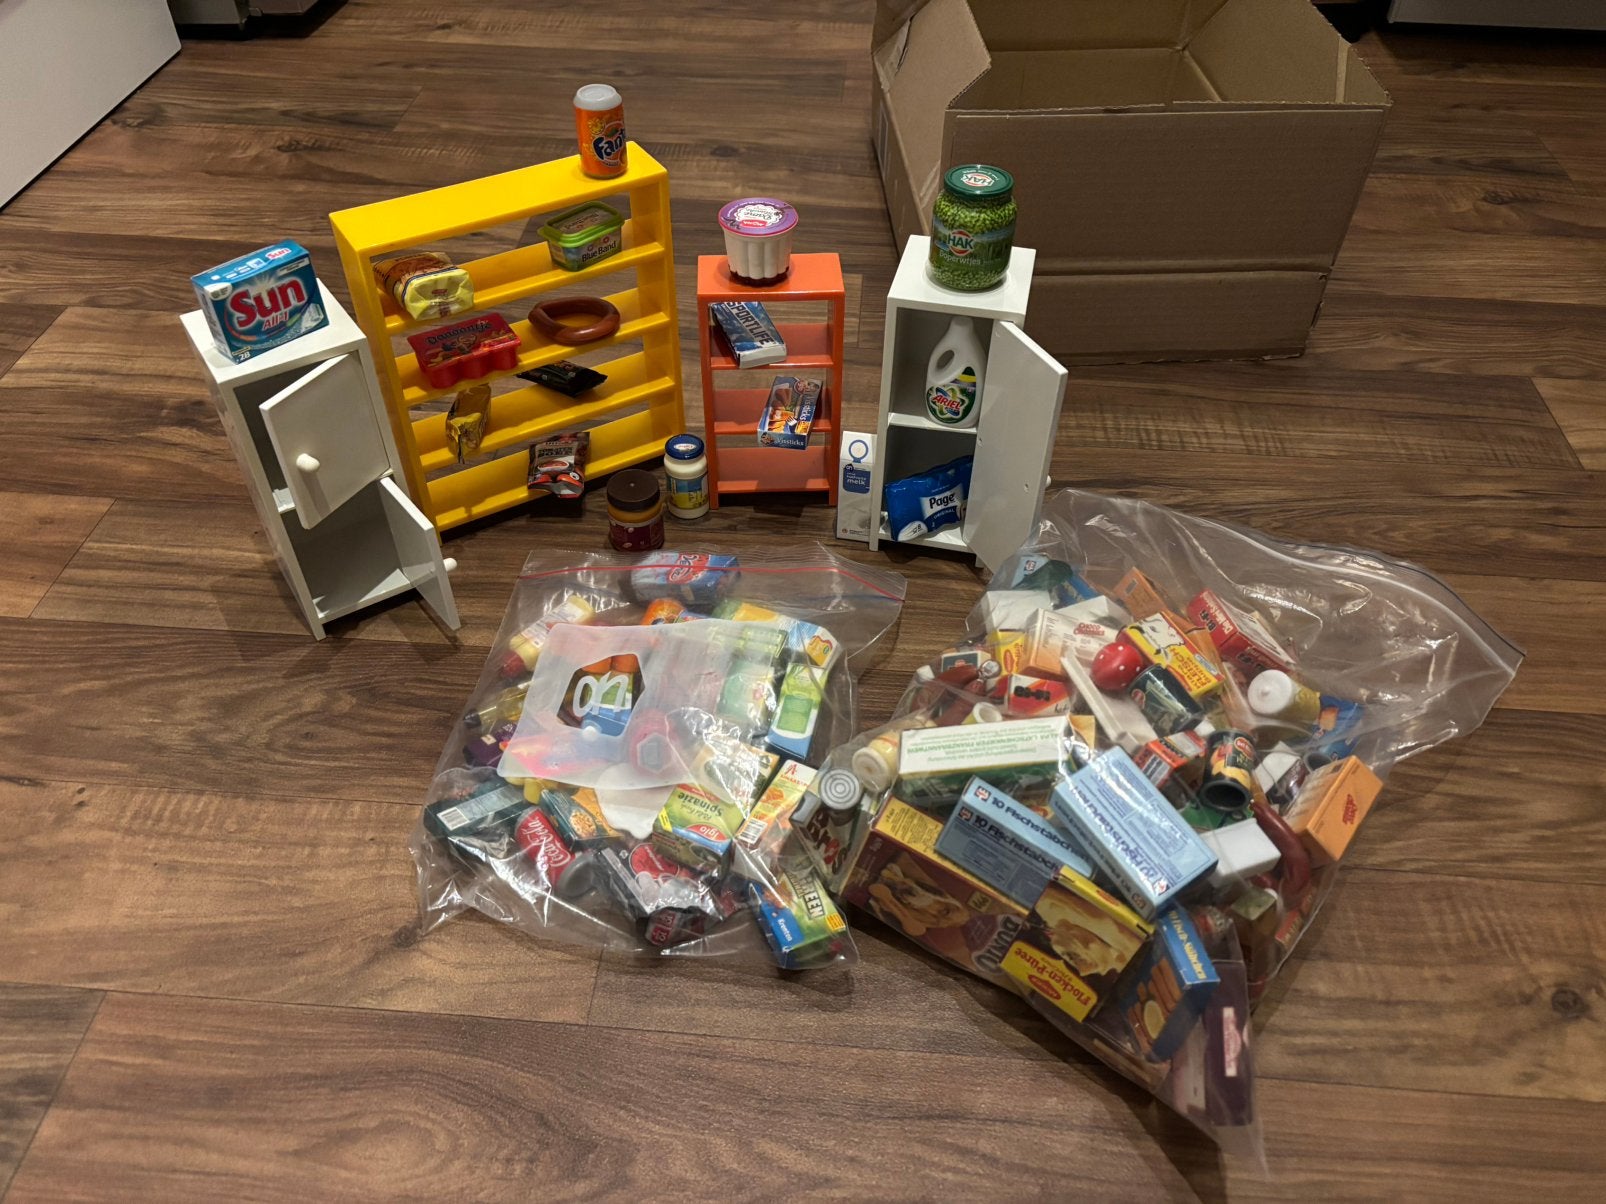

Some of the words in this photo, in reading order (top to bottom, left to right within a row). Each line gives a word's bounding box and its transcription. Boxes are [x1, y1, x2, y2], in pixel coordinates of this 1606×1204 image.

[948, 235, 974, 249] HAK
[268, 248, 290, 259] Sun
[582, 250, 597, 262] Blue
[598, 241, 617, 255] Band
[230, 279, 306, 329] Sun
[728, 301, 775, 345] SPORTLIFE
[239, 351, 250, 361] 28
[932, 394, 961, 410] ARIEL
[847, 478, 866, 486] melk
[929, 493, 956, 509] Page
[678, 791, 724, 817] Spinazie
[992, 797, 1005, 810] 10
[973, 813, 988, 830] 10
